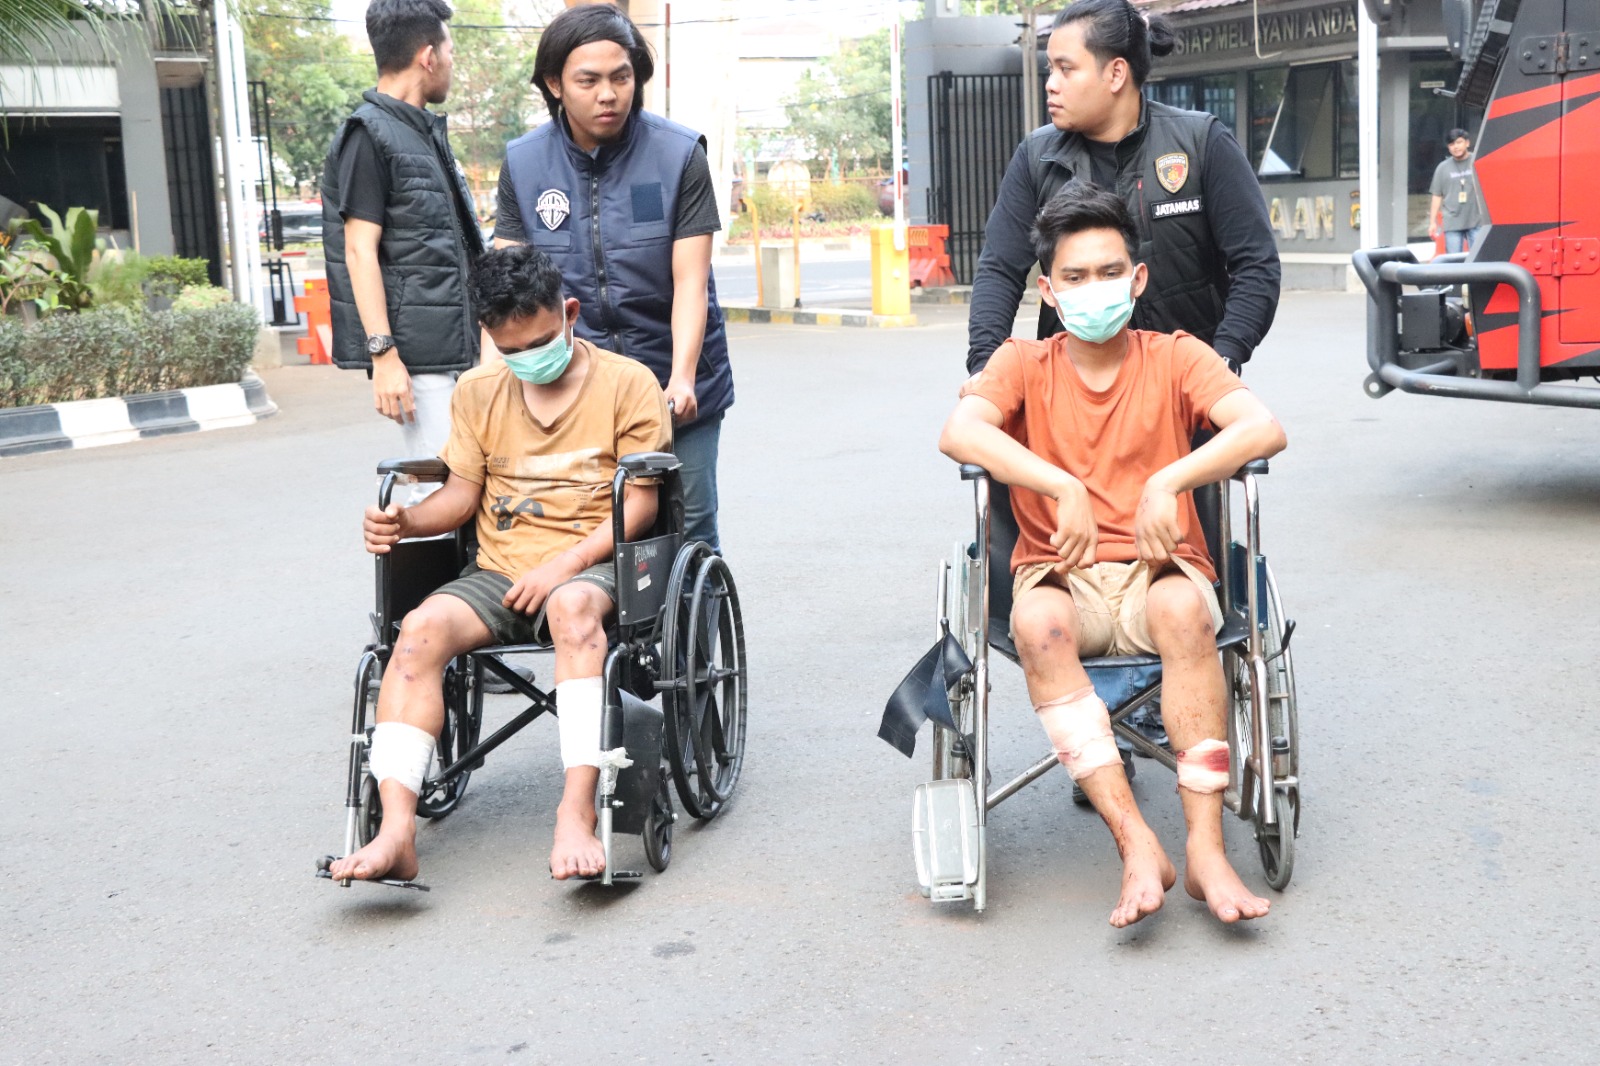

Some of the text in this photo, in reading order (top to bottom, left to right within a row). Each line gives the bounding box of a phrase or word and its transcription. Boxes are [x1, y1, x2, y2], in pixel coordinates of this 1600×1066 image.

[1174, 28, 1213, 55] SIAP
[1303, 6, 1357, 39] ANDA
[1155, 199, 1200, 216] JATANRAS
